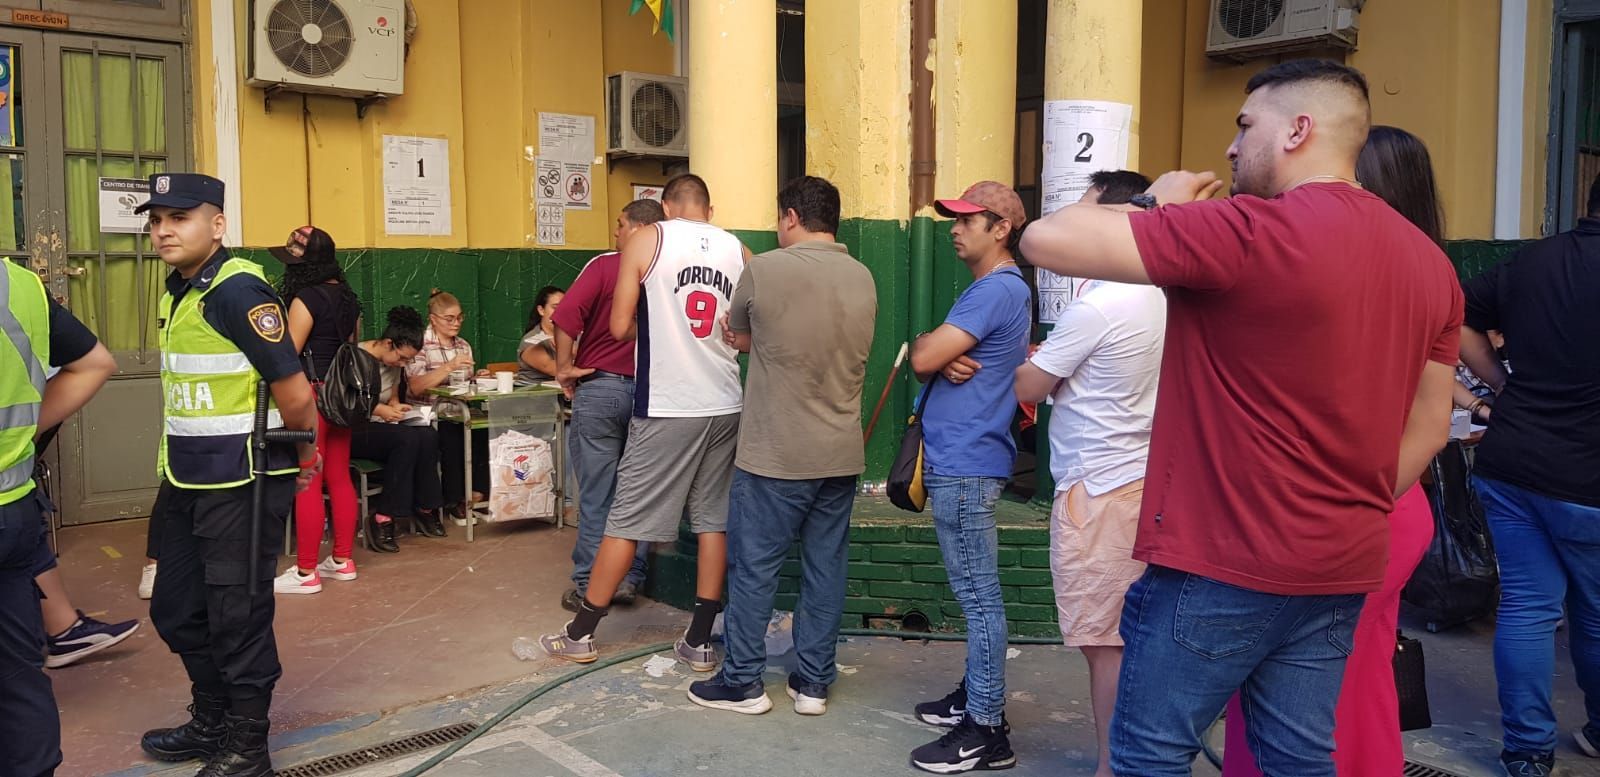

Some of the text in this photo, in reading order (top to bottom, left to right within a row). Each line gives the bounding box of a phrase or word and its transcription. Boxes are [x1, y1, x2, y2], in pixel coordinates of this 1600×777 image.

[1074, 132, 1094, 163] 2
[416, 157, 425, 178] 1
[674, 266, 733, 302] JORDAN
[685, 290, 717, 339] 9
